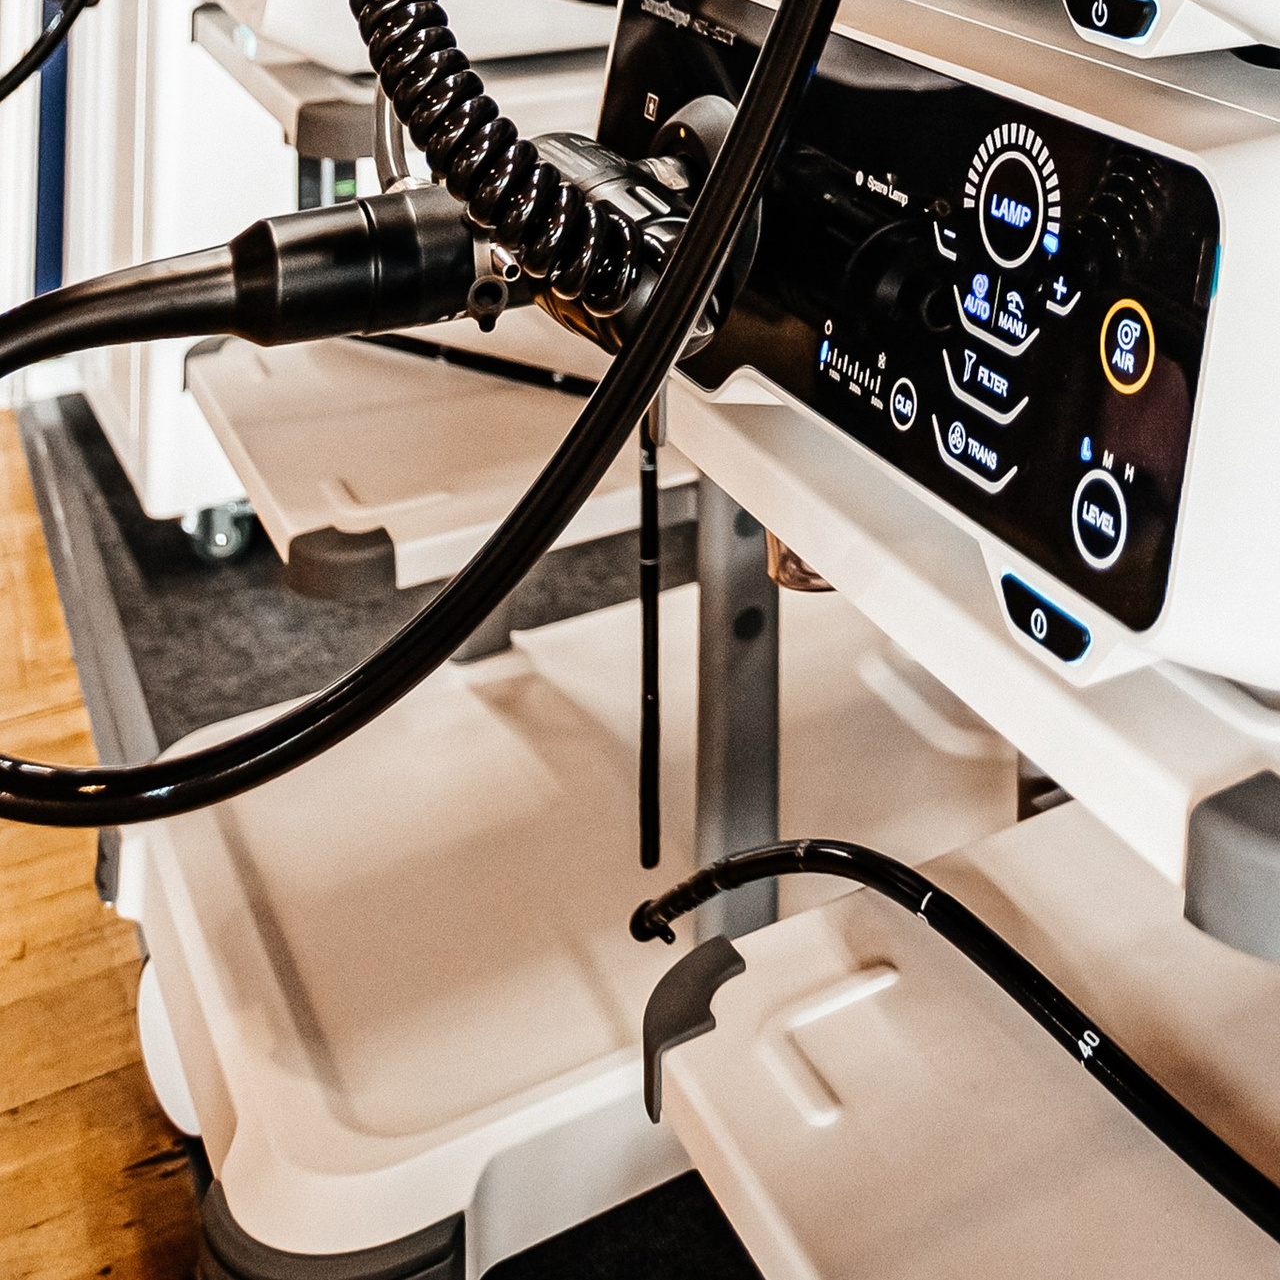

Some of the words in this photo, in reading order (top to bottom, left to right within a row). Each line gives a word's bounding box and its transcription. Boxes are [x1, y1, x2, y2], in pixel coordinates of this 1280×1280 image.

[867, 174, 888, 196] Spare
[888, 184, 908, 207] Lamp
[989, 193, 1032, 229] LAMP
[964, 294, 990, 322] AUTO
[998, 310, 1028, 340] MANU
[1112, 350, 1135, 374] AIR
[977, 364, 1008, 398] FILTER
[894, 393, 913, 418] CLR
[967, 437, 998, 471] TRANS
[1103, 449, 1115, 471] M
[1125, 461, 1135, 484] H
[1081, 499, 1116, 538] LEVEL
[1077, 1030, 1100, 1059] 40
